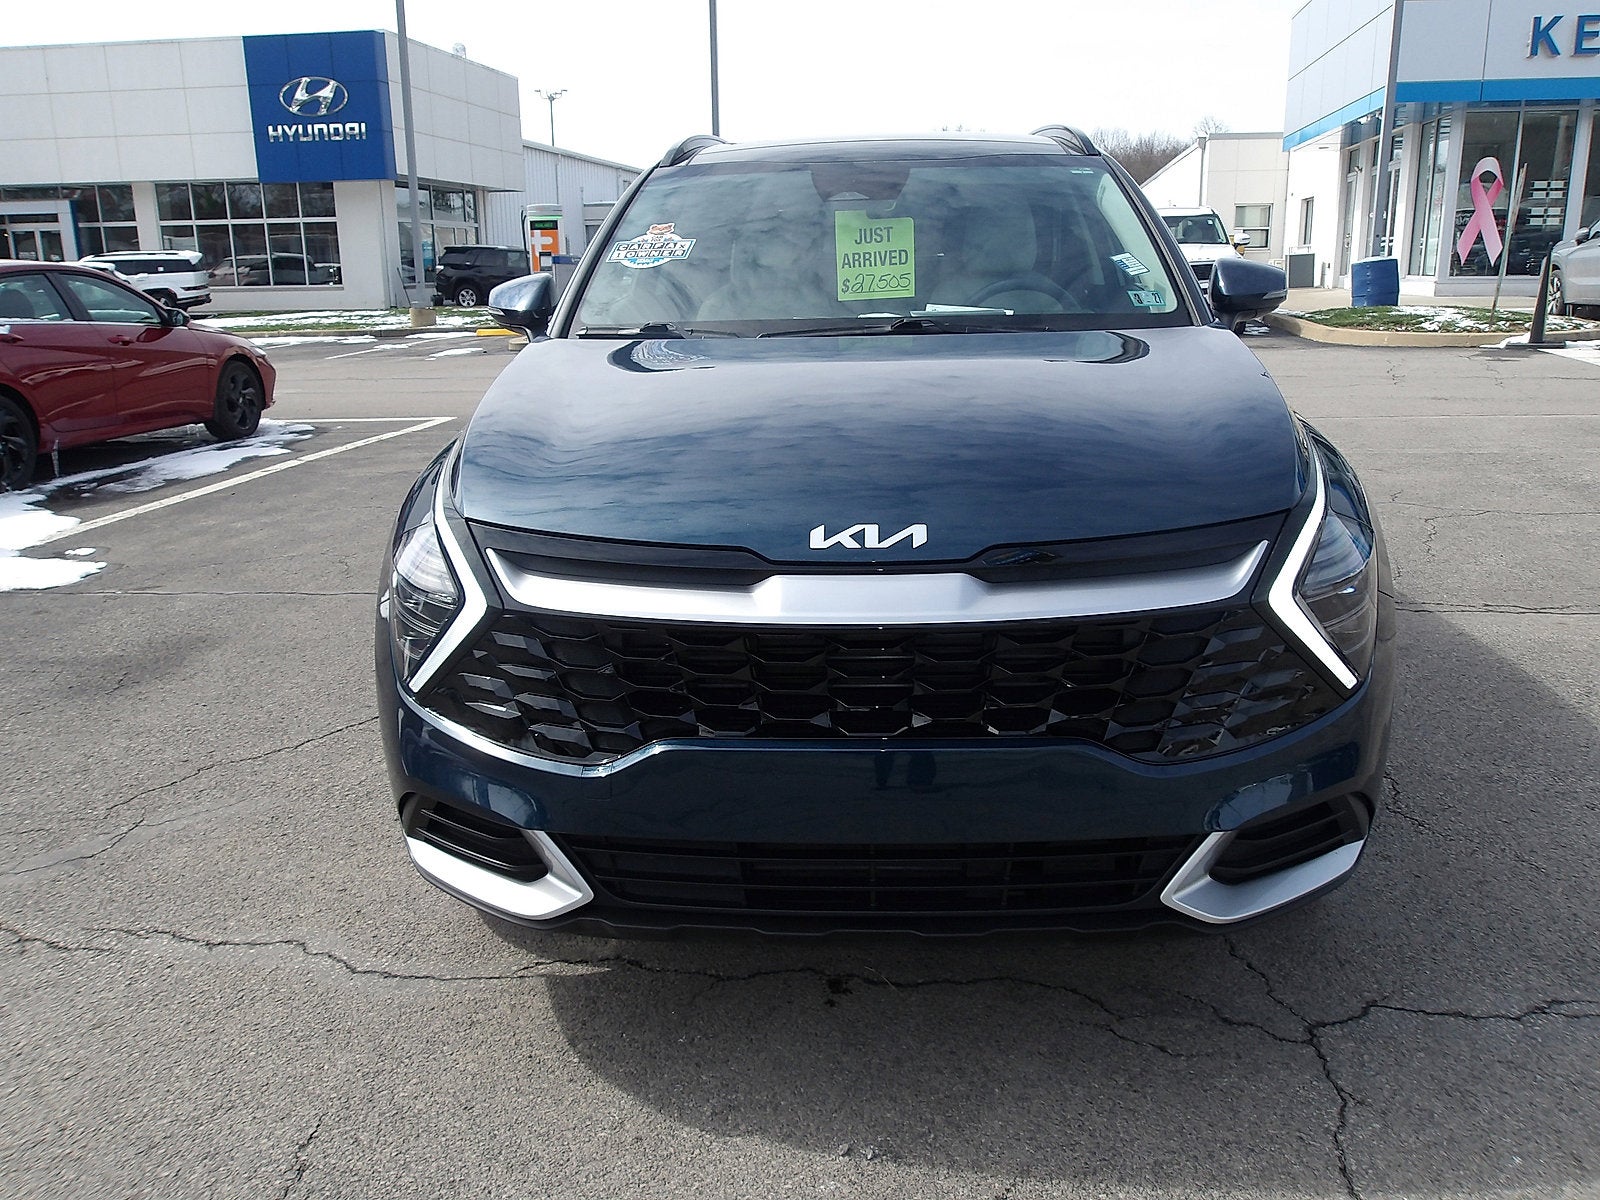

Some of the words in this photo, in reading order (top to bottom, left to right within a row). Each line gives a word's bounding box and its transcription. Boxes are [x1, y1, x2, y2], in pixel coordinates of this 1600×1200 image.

[1529, 14, 1600, 57] KE
[267, 122, 367, 143] HYUNDAI
[854, 226, 894, 245] JUST
[616, 242, 687, 251] CARFAX
[624, 250, 686, 258] OWNER
[841, 249, 909, 269] ARRIVED
[809, 523, 928, 549] KIA
